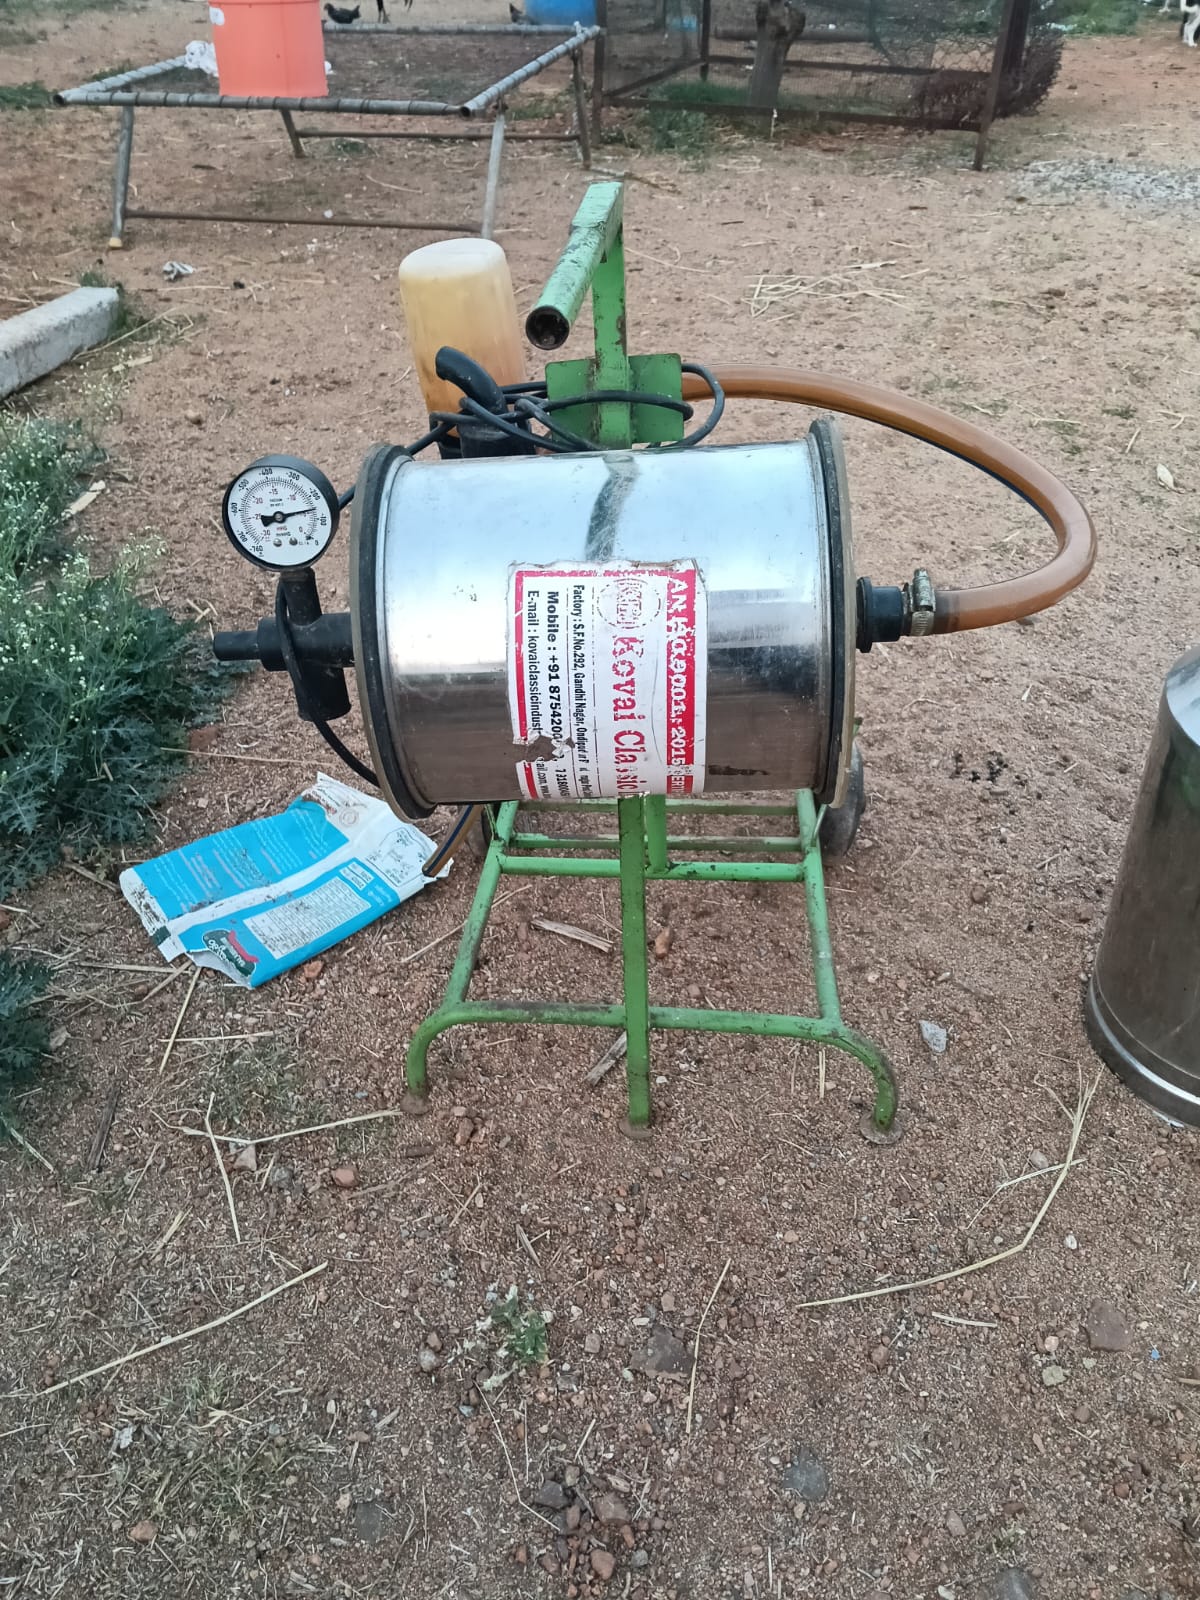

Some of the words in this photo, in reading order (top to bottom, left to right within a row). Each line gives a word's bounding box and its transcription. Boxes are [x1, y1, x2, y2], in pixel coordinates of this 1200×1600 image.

[527, 590, 540, 626] E-mail
[547, 591, 560, 643] Mobile
[570, 584, 585, 617] Factory
[548, 655, 560, 682] +91
[613, 636, 645, 722] Kovai
[574, 672, 587, 702] Gandhi
[573, 702, 587, 727] Nagar,
[671, 726, 687, 765] 2015
